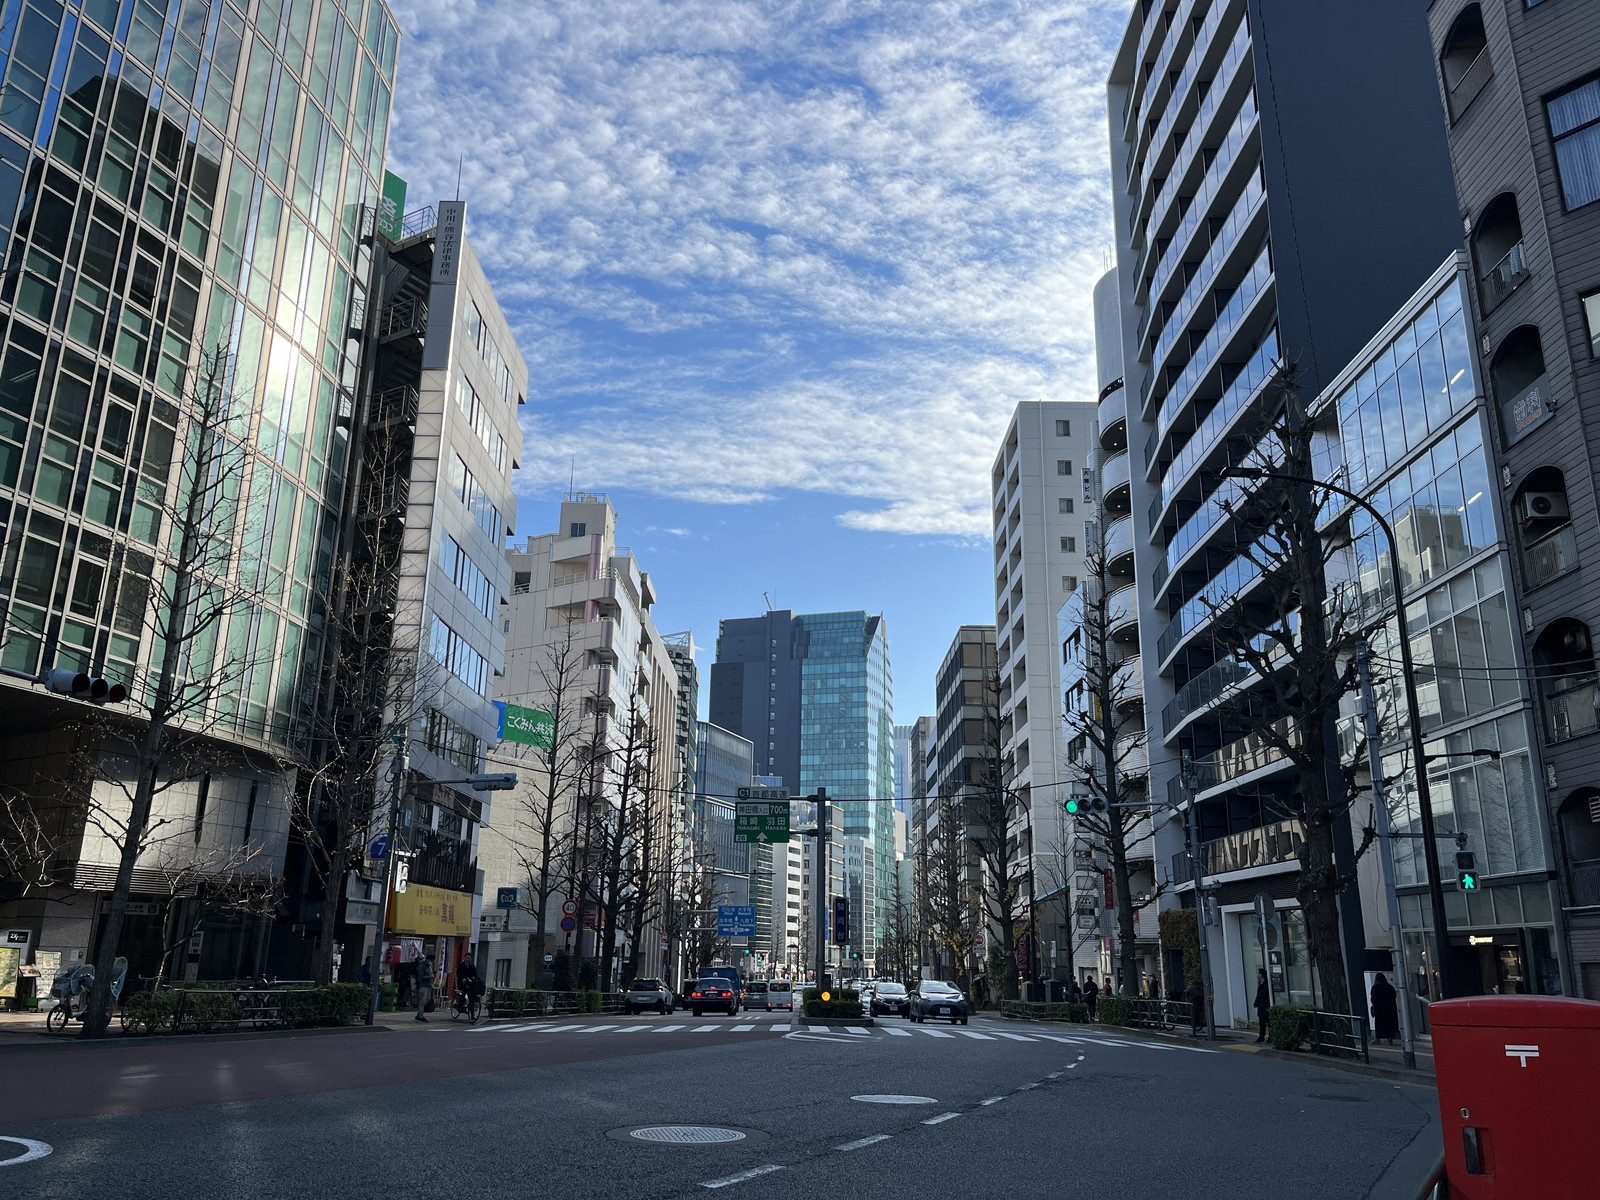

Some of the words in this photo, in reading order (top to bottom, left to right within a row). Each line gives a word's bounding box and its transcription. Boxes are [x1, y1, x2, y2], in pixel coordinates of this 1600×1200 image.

[739, 788, 750, 797] C1
[752, 790, 788, 798] 首都高速
[766, 816, 786, 825] 羽田
[565, 903, 575, 912] 40
